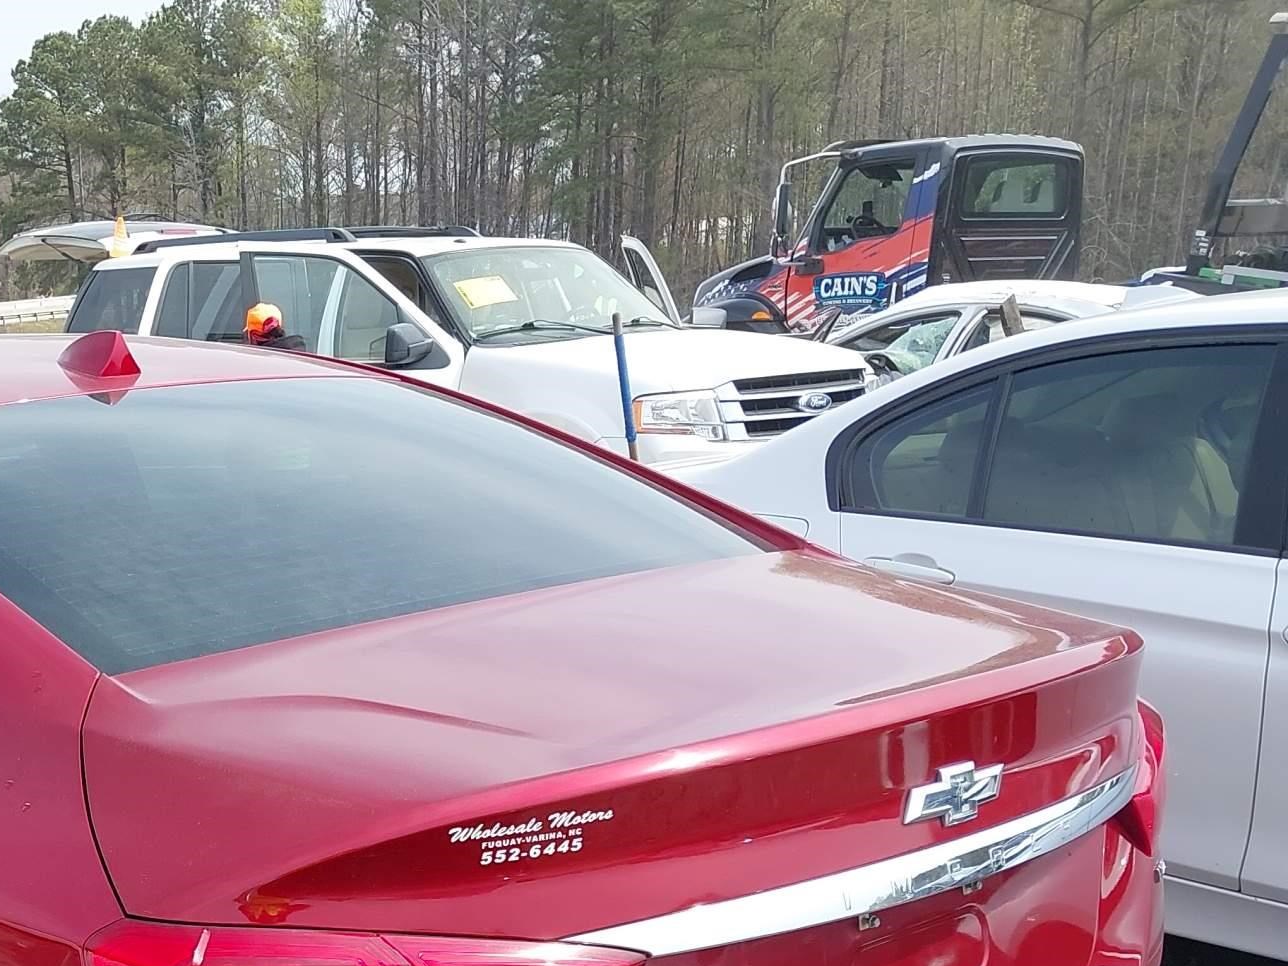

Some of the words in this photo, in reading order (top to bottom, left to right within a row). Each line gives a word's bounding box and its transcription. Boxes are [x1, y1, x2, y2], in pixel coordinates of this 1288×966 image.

[820, 275, 878, 298] CAIN'S
[449, 818, 543, 843] Wholesale
[547, 809, 614, 829] Motors
[480, 837, 583, 865] 552-6445
[481, 831, 566, 850] FUQUAY-VARINA,
[568, 828, 583, 837] NC
